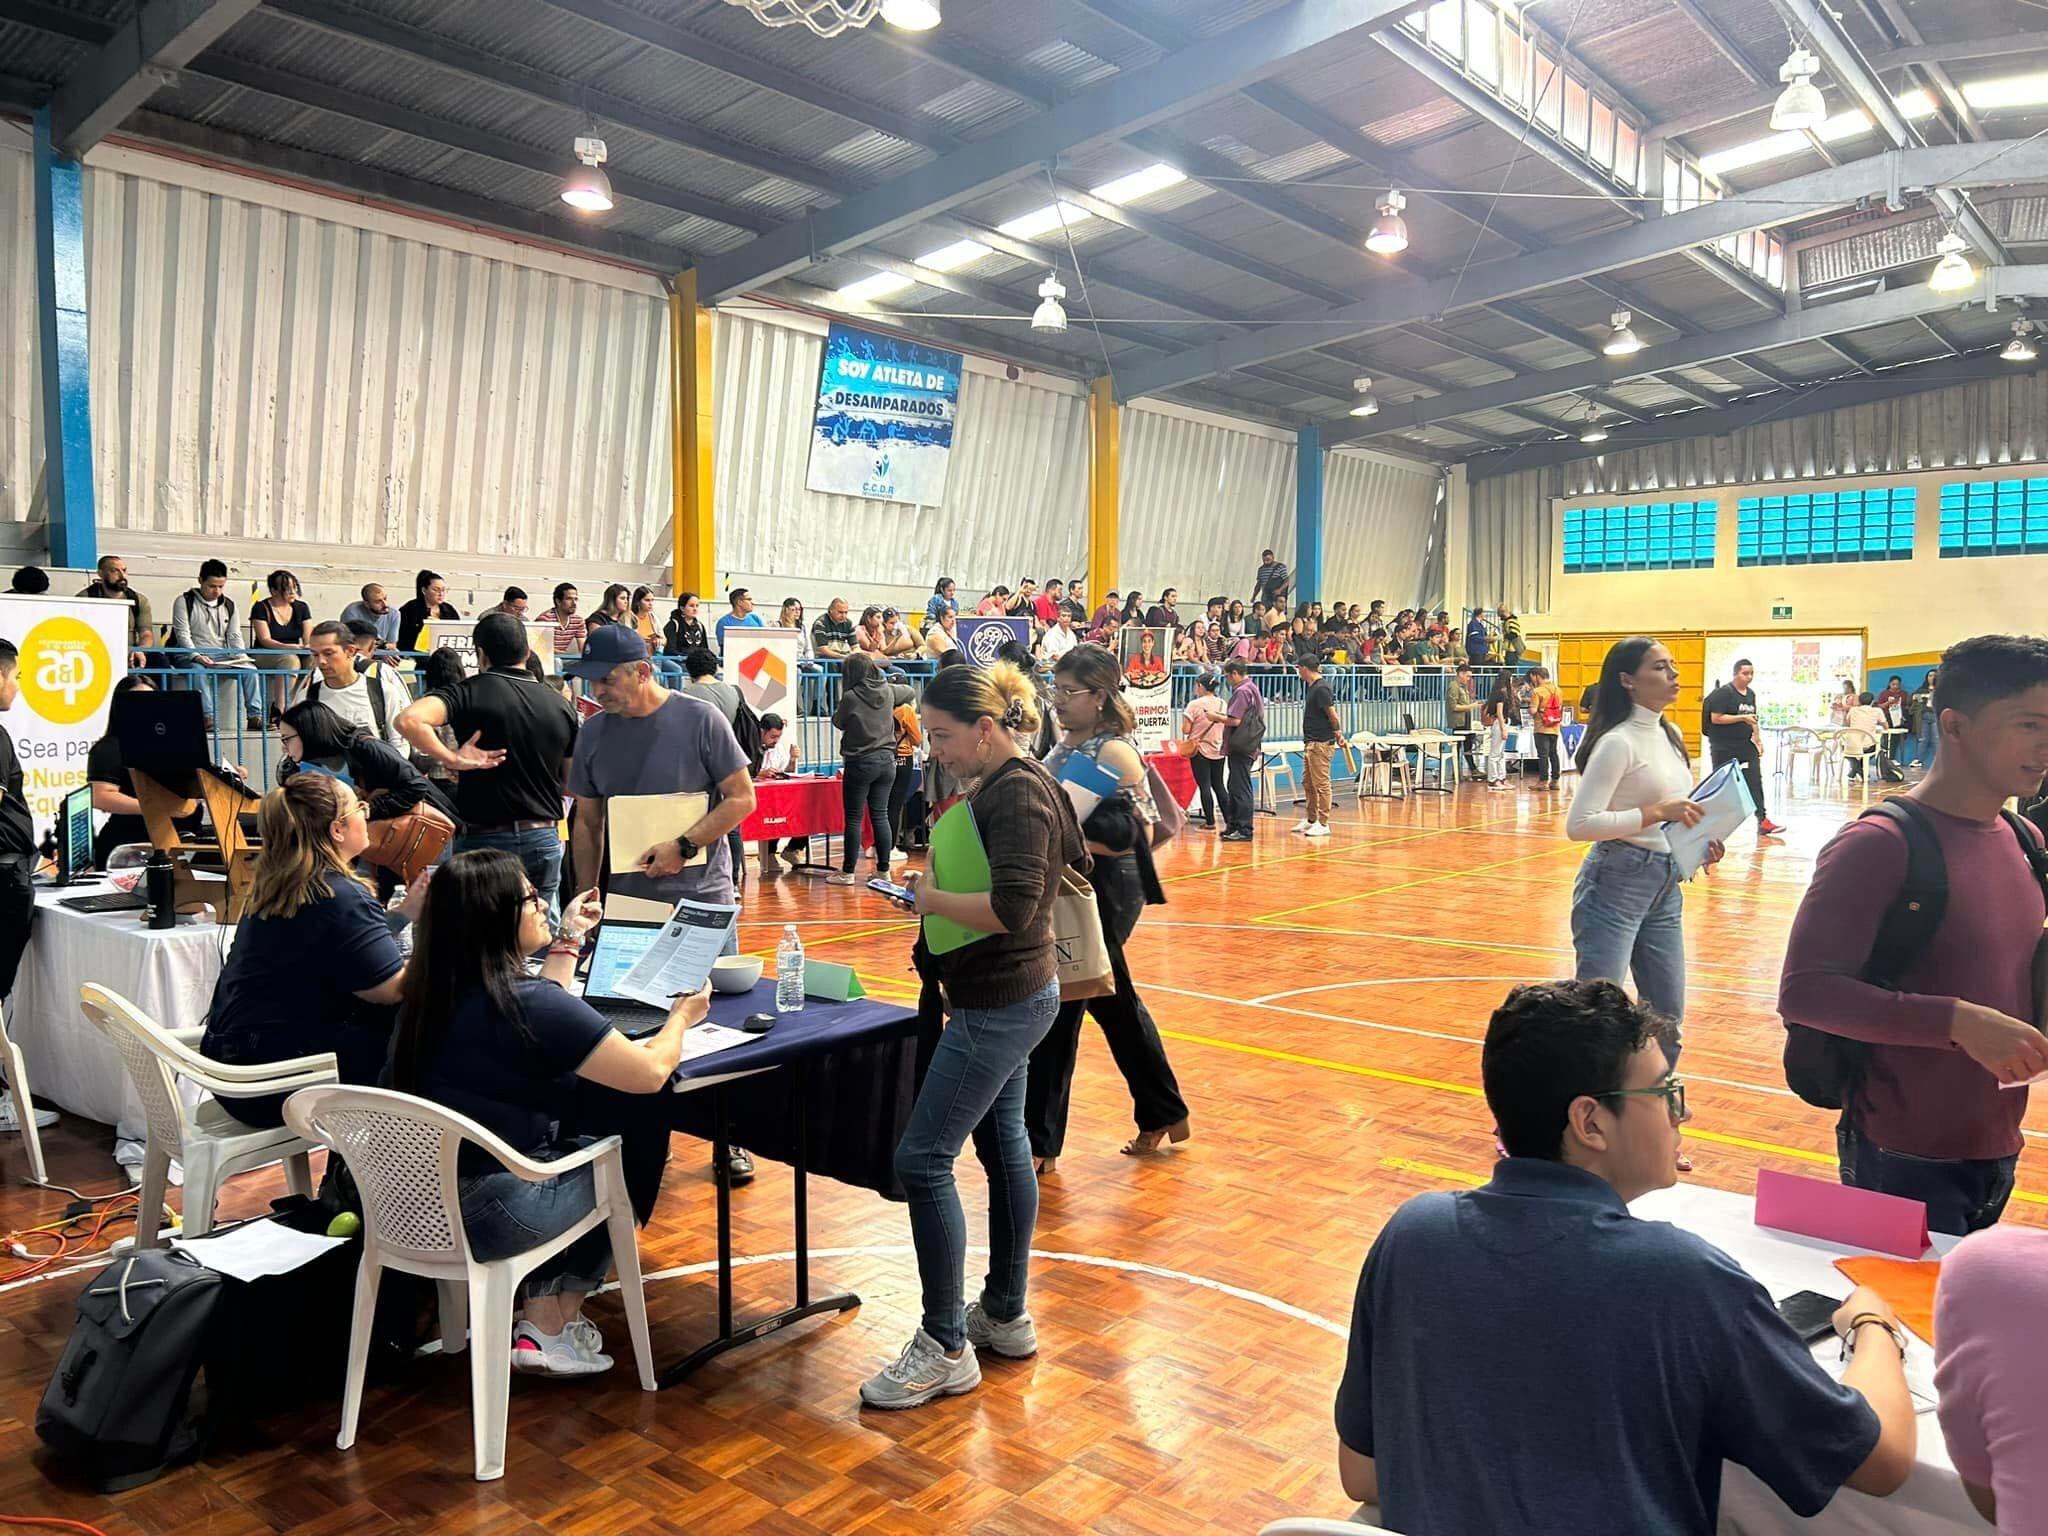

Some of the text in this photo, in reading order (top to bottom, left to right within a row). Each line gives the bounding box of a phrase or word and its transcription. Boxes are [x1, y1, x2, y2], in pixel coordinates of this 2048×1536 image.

[838, 358, 945, 391] SOY ATLETA DE
[835, 391, 944, 416] DESAMPARADOS
[438, 634, 476, 650] FERI
[18, 738, 97, 761] Sea pa
